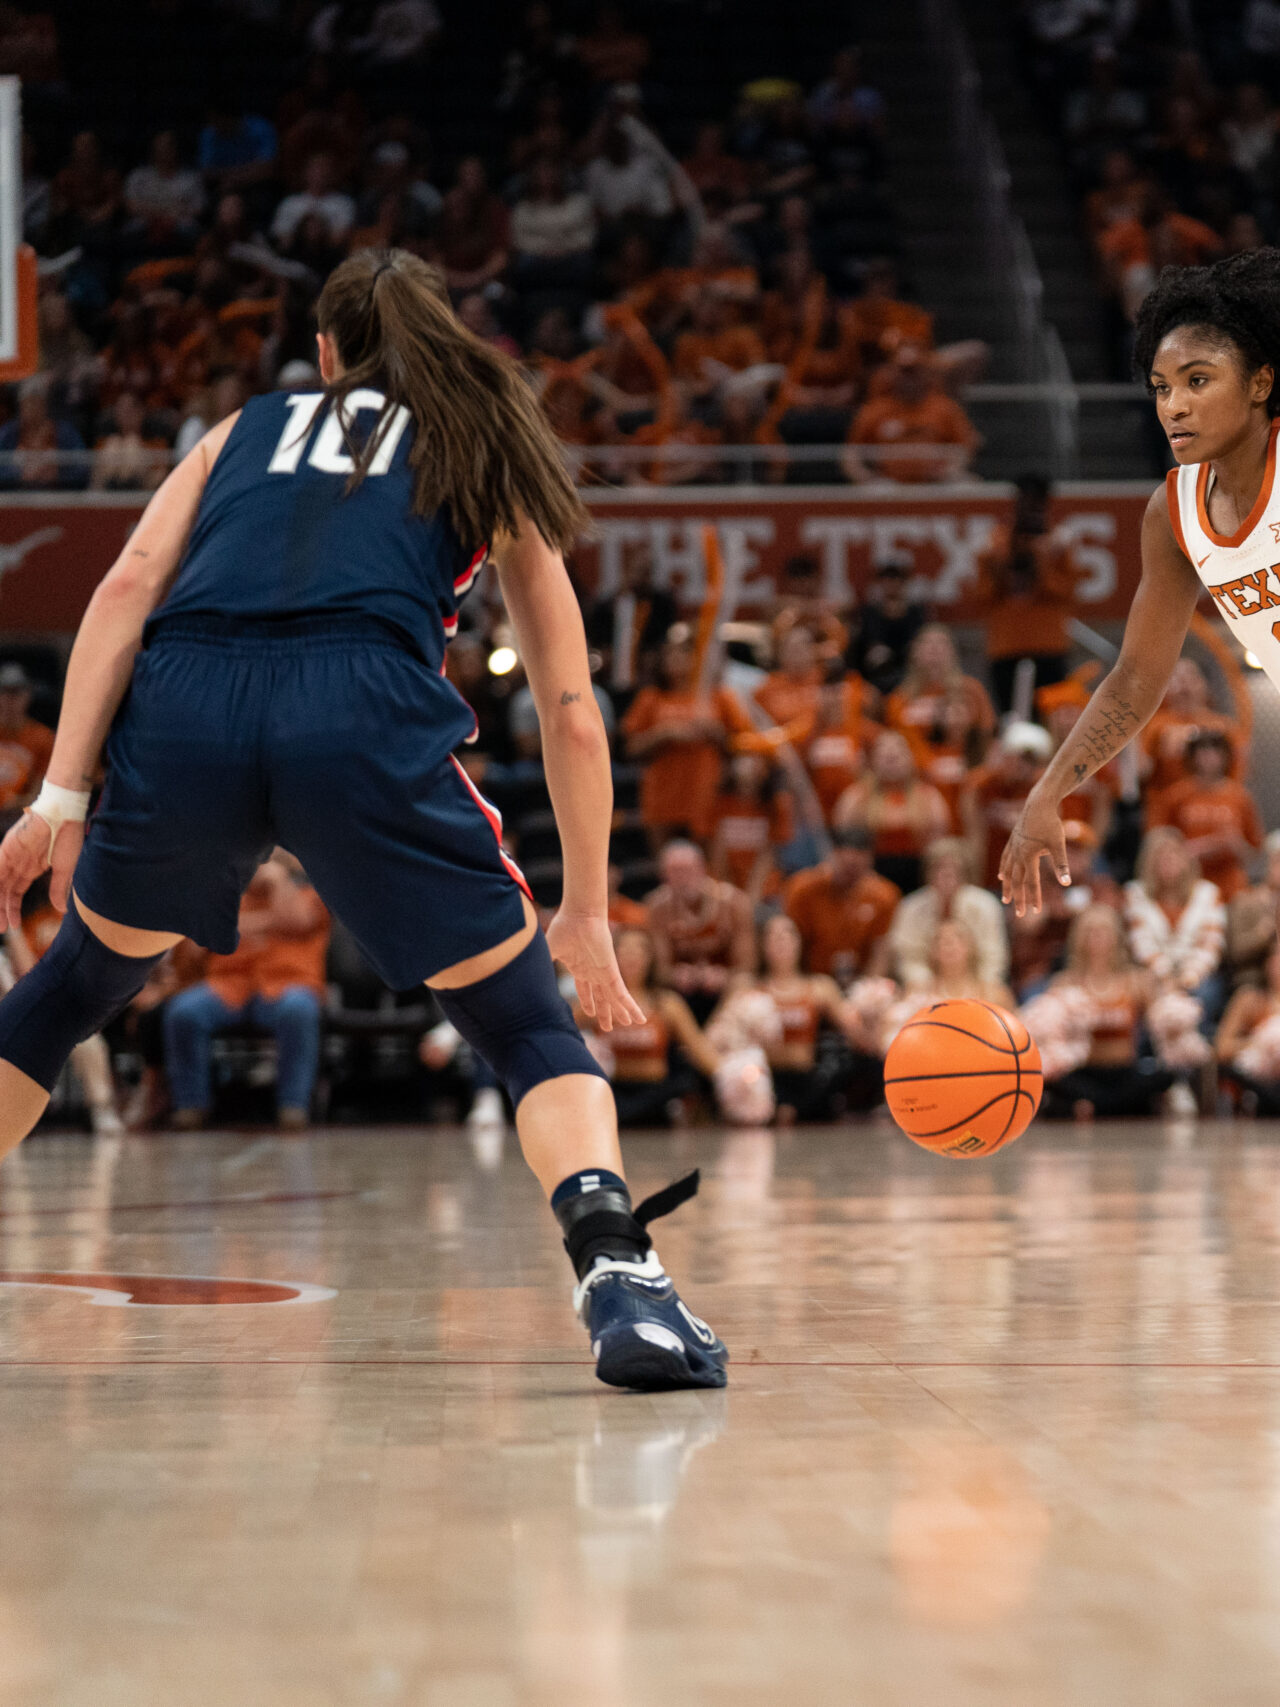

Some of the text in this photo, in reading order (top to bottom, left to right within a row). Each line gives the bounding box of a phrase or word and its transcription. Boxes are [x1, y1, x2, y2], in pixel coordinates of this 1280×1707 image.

[267, 388, 411, 475] 10
[588, 517, 774, 604] THE
[803, 514, 1118, 602] TEXS
